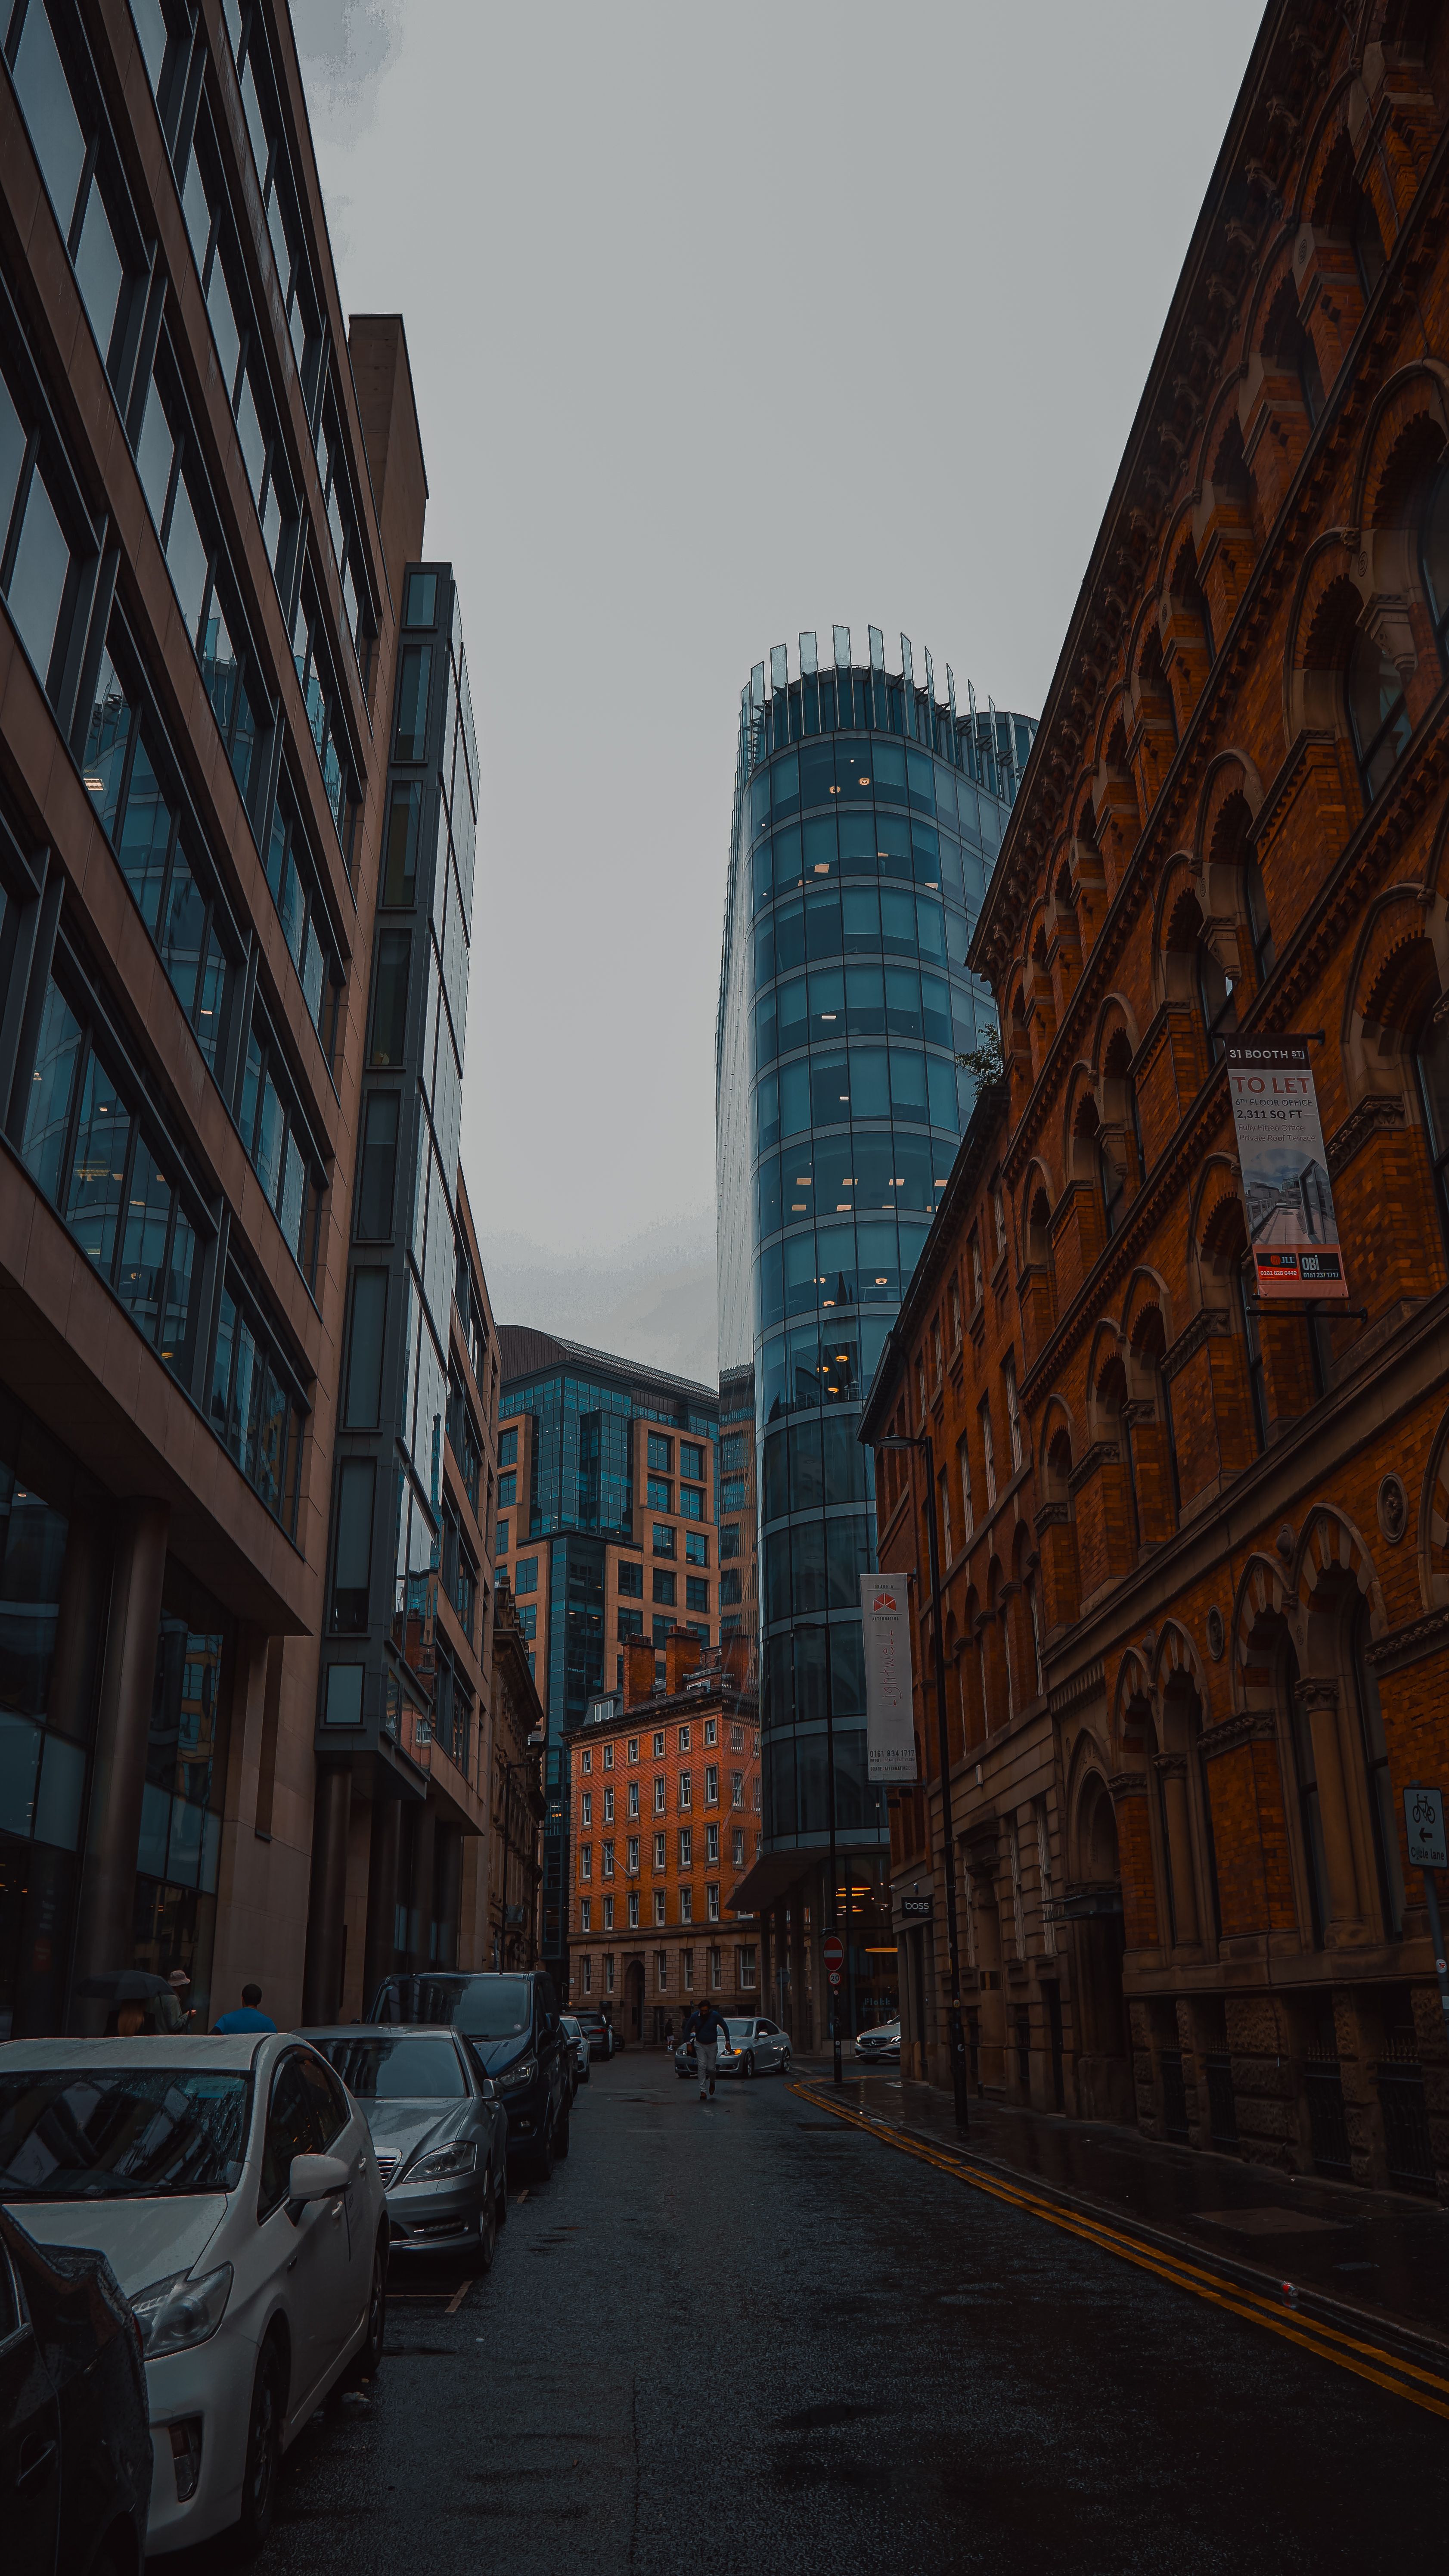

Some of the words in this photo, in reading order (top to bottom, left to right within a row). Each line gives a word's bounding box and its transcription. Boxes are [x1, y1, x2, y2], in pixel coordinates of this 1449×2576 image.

[1229, 1050, 1241, 1058] 31
[1245, 1050, 1288, 1059] BOOTH
[1232, 1077, 1265, 1094] TO
[1272, 1077, 1310, 1094] LET
[1237, 1110, 1267, 1119] 2,311
[1270, 1110, 1287, 1120] SQ
[1289, 1110, 1302, 1119] FT
[1411, 1846, 1428, 1860] Ccle
[1430, 1848, 1444, 1861] lane
[905, 1901, 929, 1910] boss
